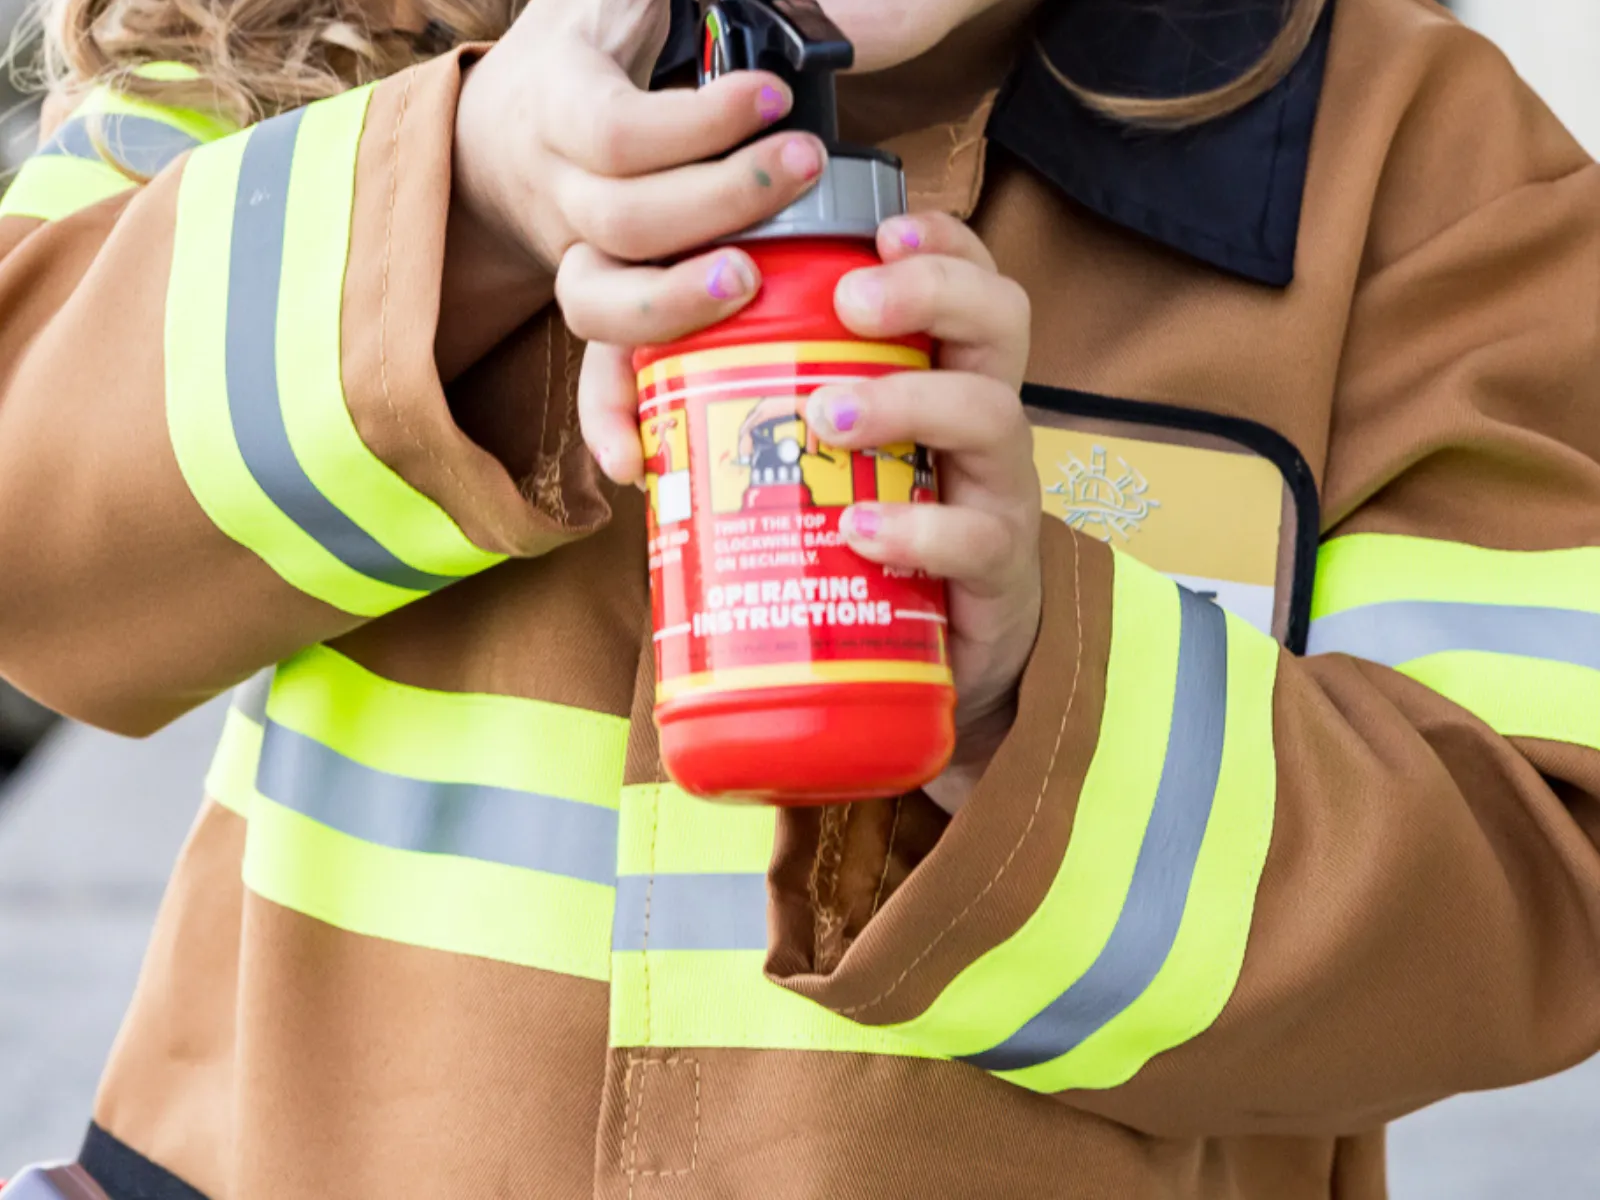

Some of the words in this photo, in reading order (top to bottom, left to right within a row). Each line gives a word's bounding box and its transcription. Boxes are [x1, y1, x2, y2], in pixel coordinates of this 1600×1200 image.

[761, 515, 791, 532] THE
[795, 513, 826, 529] TOP
[714, 533, 799, 554] CLOCKWISE
[715, 556, 736, 573] ON
[707, 576, 868, 609] OPERATING
[692, 600, 892, 638] INSTRUCTIONS
